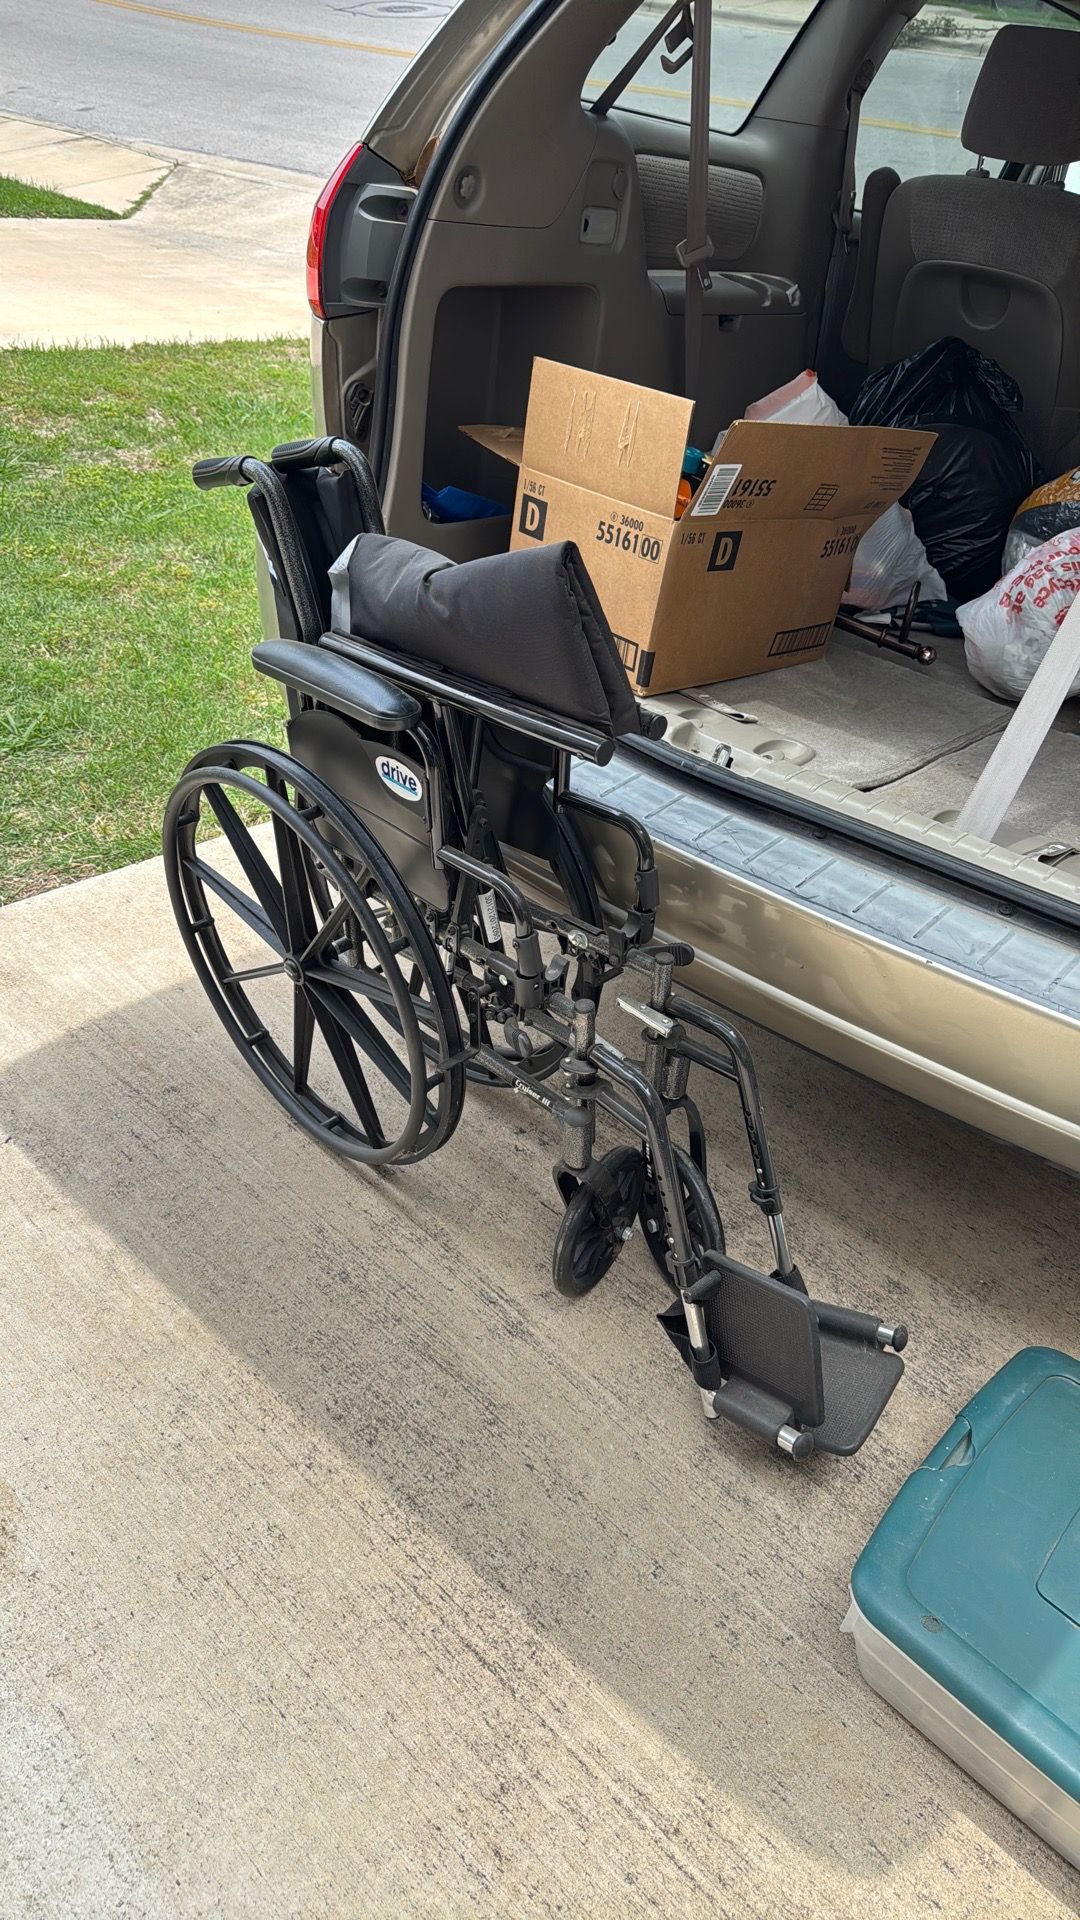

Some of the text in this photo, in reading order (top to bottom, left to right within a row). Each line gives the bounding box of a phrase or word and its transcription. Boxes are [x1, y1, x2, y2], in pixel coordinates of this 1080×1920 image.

[525, 501, 540, 532] D
[619, 514, 644, 532] 36000
[595, 520, 661, 561] 5516100
[715, 537, 734, 566] D
[1048, 546, 1080, 562] our
[381, 760, 417, 792] drive
[515, 1079, 551, 1107] Cruiser III
